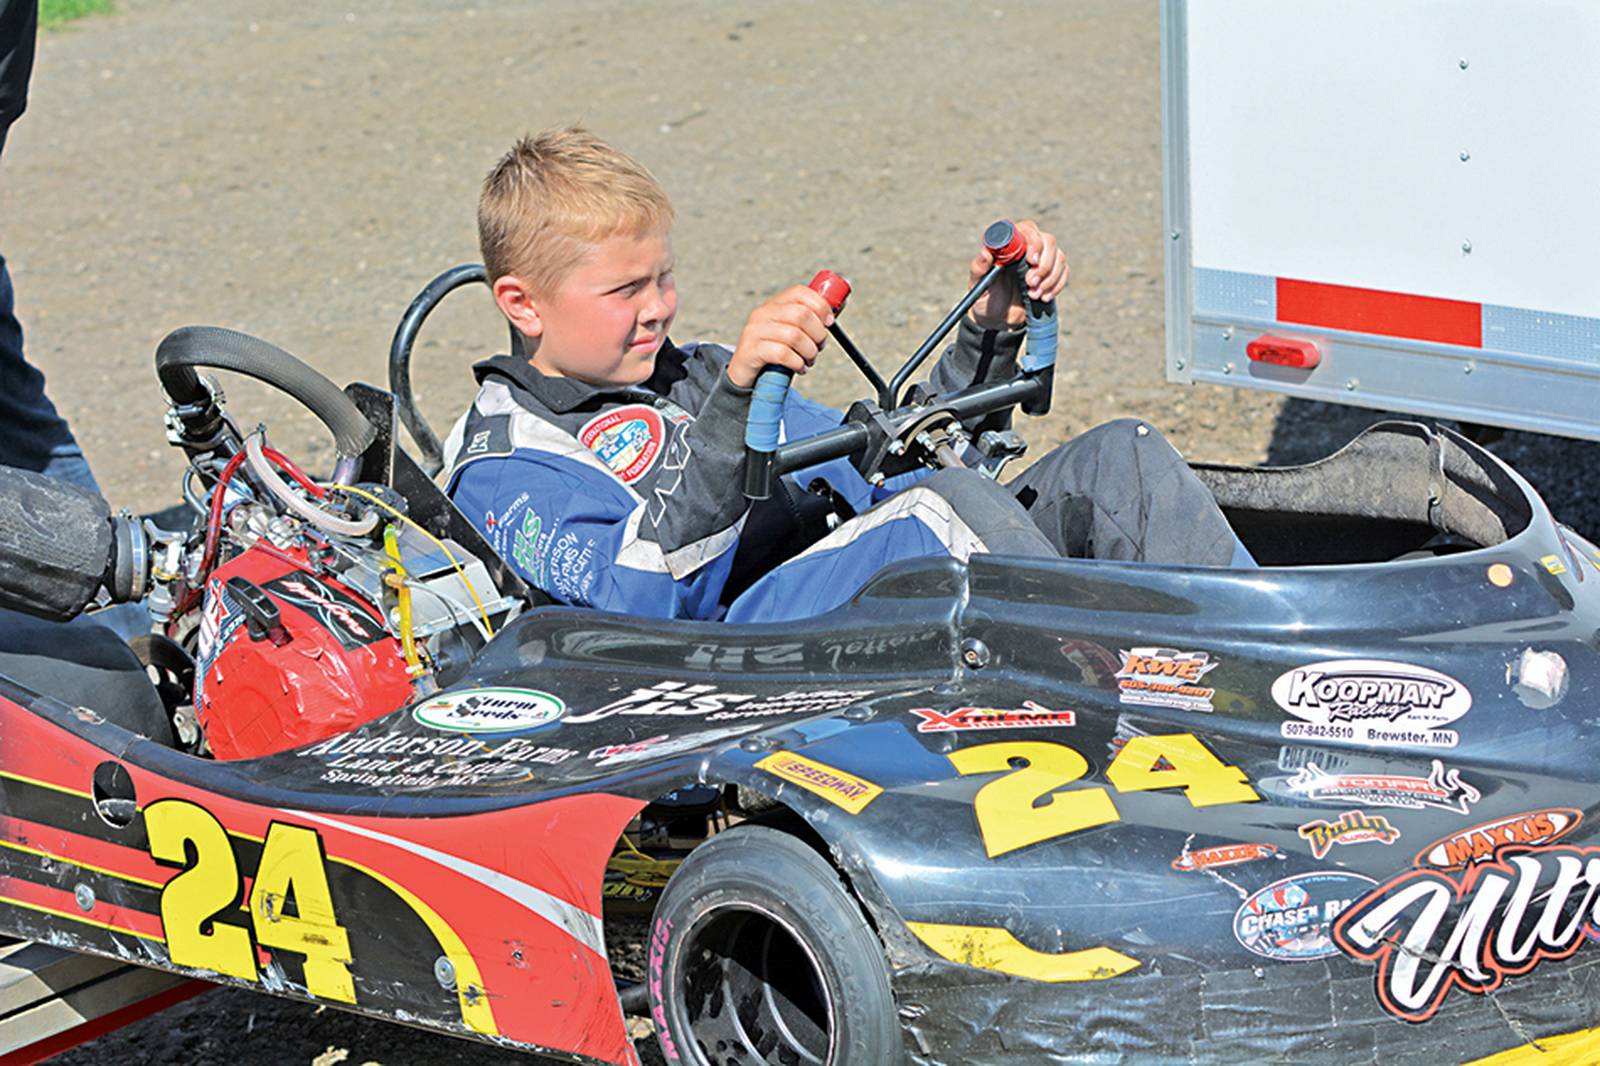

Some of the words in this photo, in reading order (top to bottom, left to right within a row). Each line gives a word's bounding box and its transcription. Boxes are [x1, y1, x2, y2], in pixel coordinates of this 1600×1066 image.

[1123, 655, 1202, 680] KWE
[1288, 670, 1456, 709] KOOPMAN
[1329, 702, 1411, 723] Racing
[297, 732, 487, 757] Anderson
[1286, 723, 1354, 739] 507-842-5510
[1367, 728, 1429, 744] Brewster,
[1432, 732, 1453, 744] MN
[326, 754, 411, 772] Land
[946, 733, 1261, 859] 24
[1300, 811, 1398, 857] Bully
[1446, 812, 1555, 865] MAXXIS
[1192, 846, 1259, 866] MAXXIS
[143, 798, 357, 1004] 24
[650, 917, 680, 1061] MAXXIS
